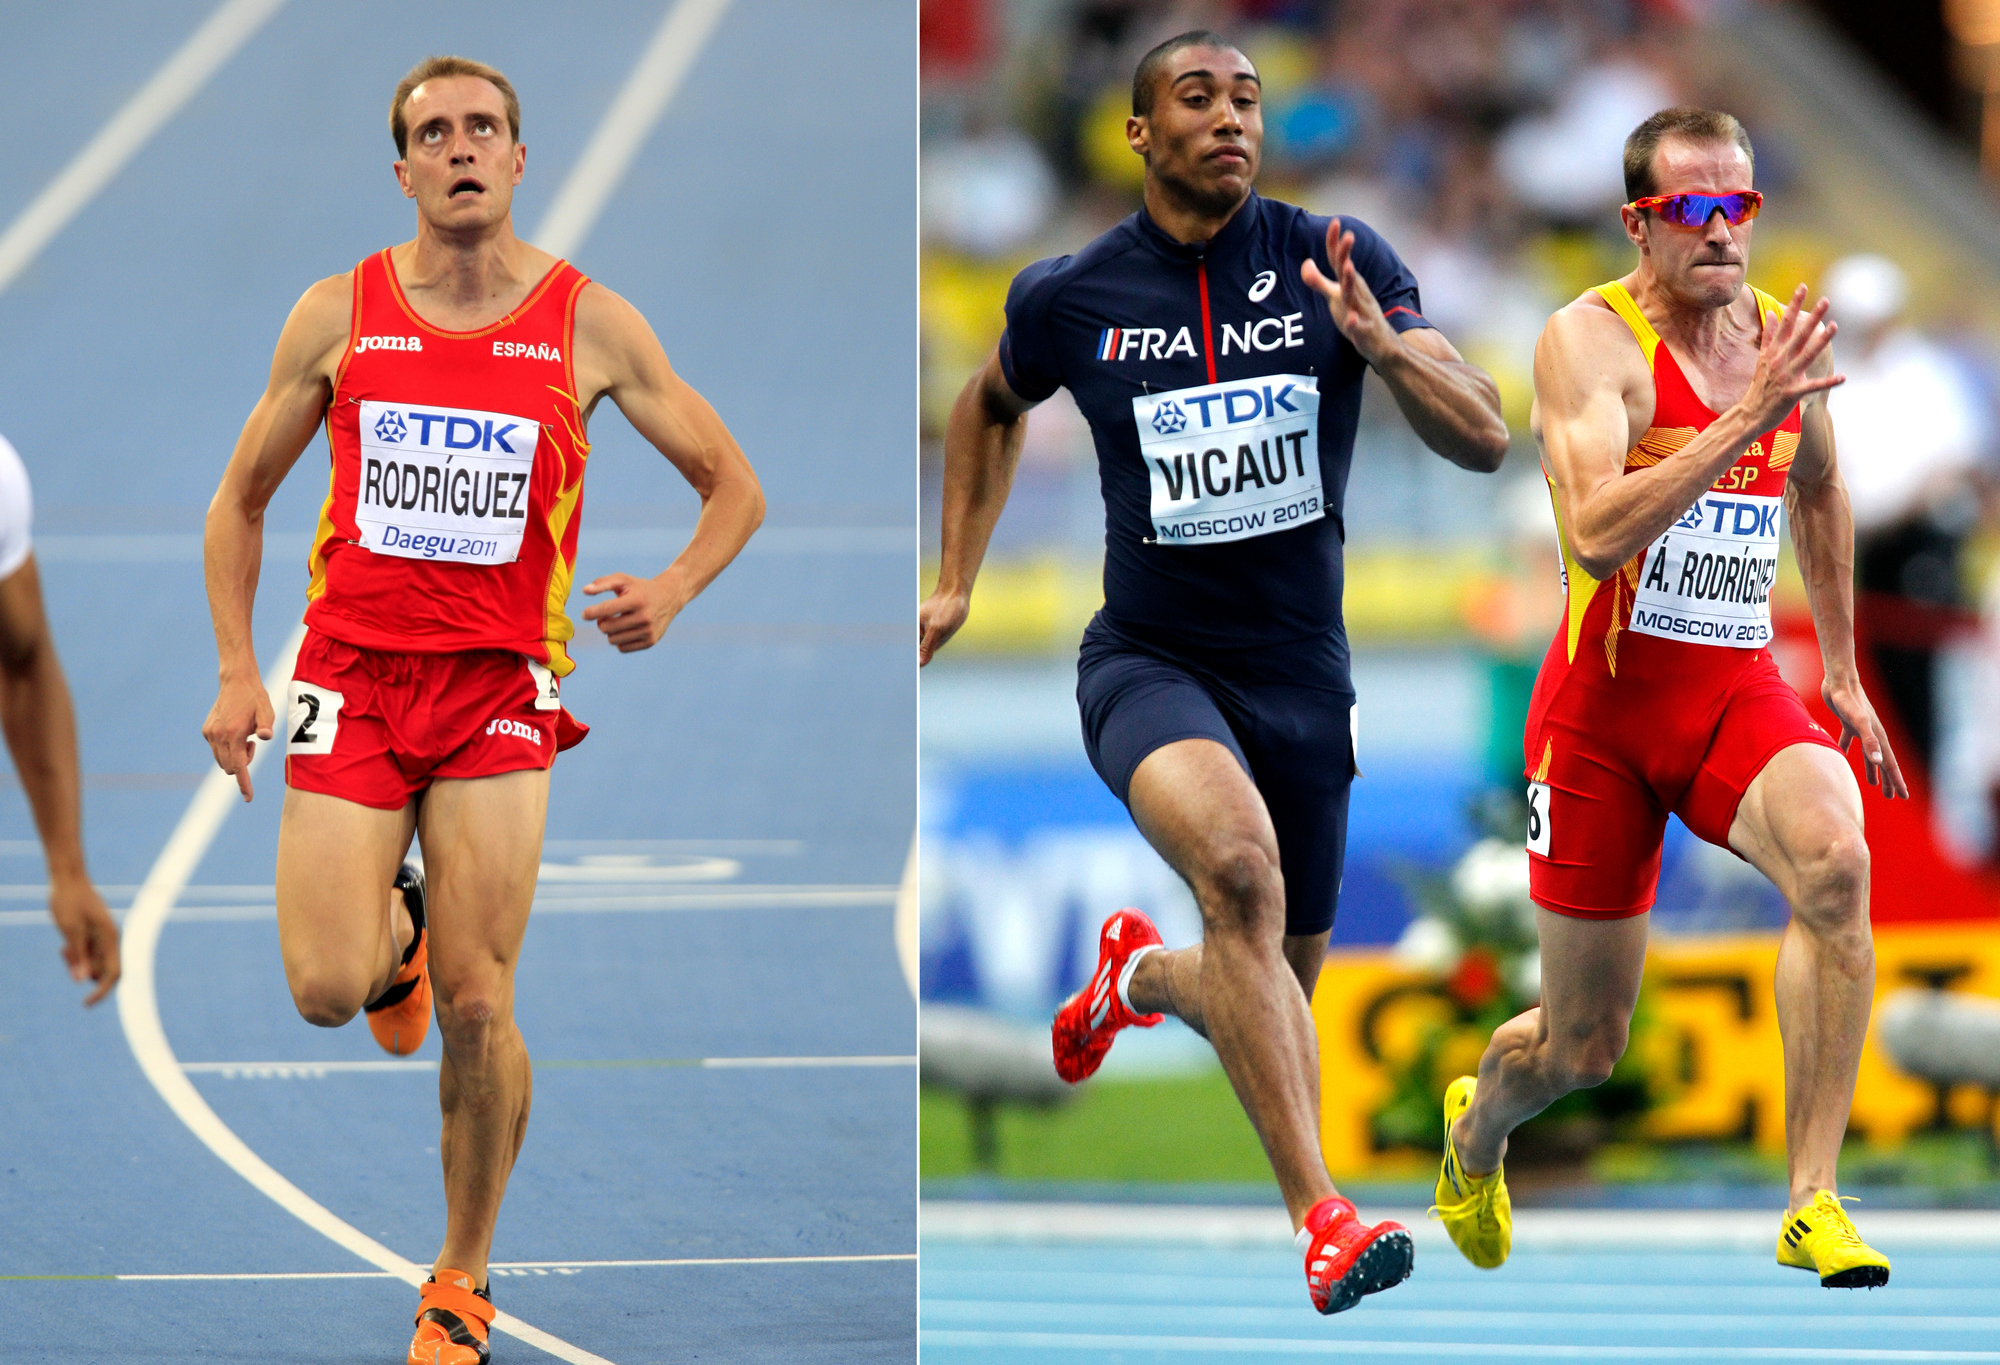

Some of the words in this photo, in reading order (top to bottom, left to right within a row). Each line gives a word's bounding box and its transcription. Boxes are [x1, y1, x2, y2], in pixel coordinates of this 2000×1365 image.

[492, 341, 562, 362] ESPAÑA
[1184, 383, 1299, 428] TDK
[408, 412, 519, 454] TDK
[1155, 429, 1309, 501] VICAUT
[364, 455, 528, 519] RODRÍGUEZ
[1160, 511, 1266, 539] MOSCOW
[1273, 497, 1319, 525] 2013
[1705, 499, 1779, 538] TDK
[381, 526, 455, 558] Daegu
[457, 538, 498, 557] 2011
[1645, 535, 1669, 593] Á.
[1636, 610, 1734, 640] MOSCOW
[1736, 625, 1769, 641] 2013
[290, 693, 320, 744] 2
[1528, 788, 1541, 841] 6
